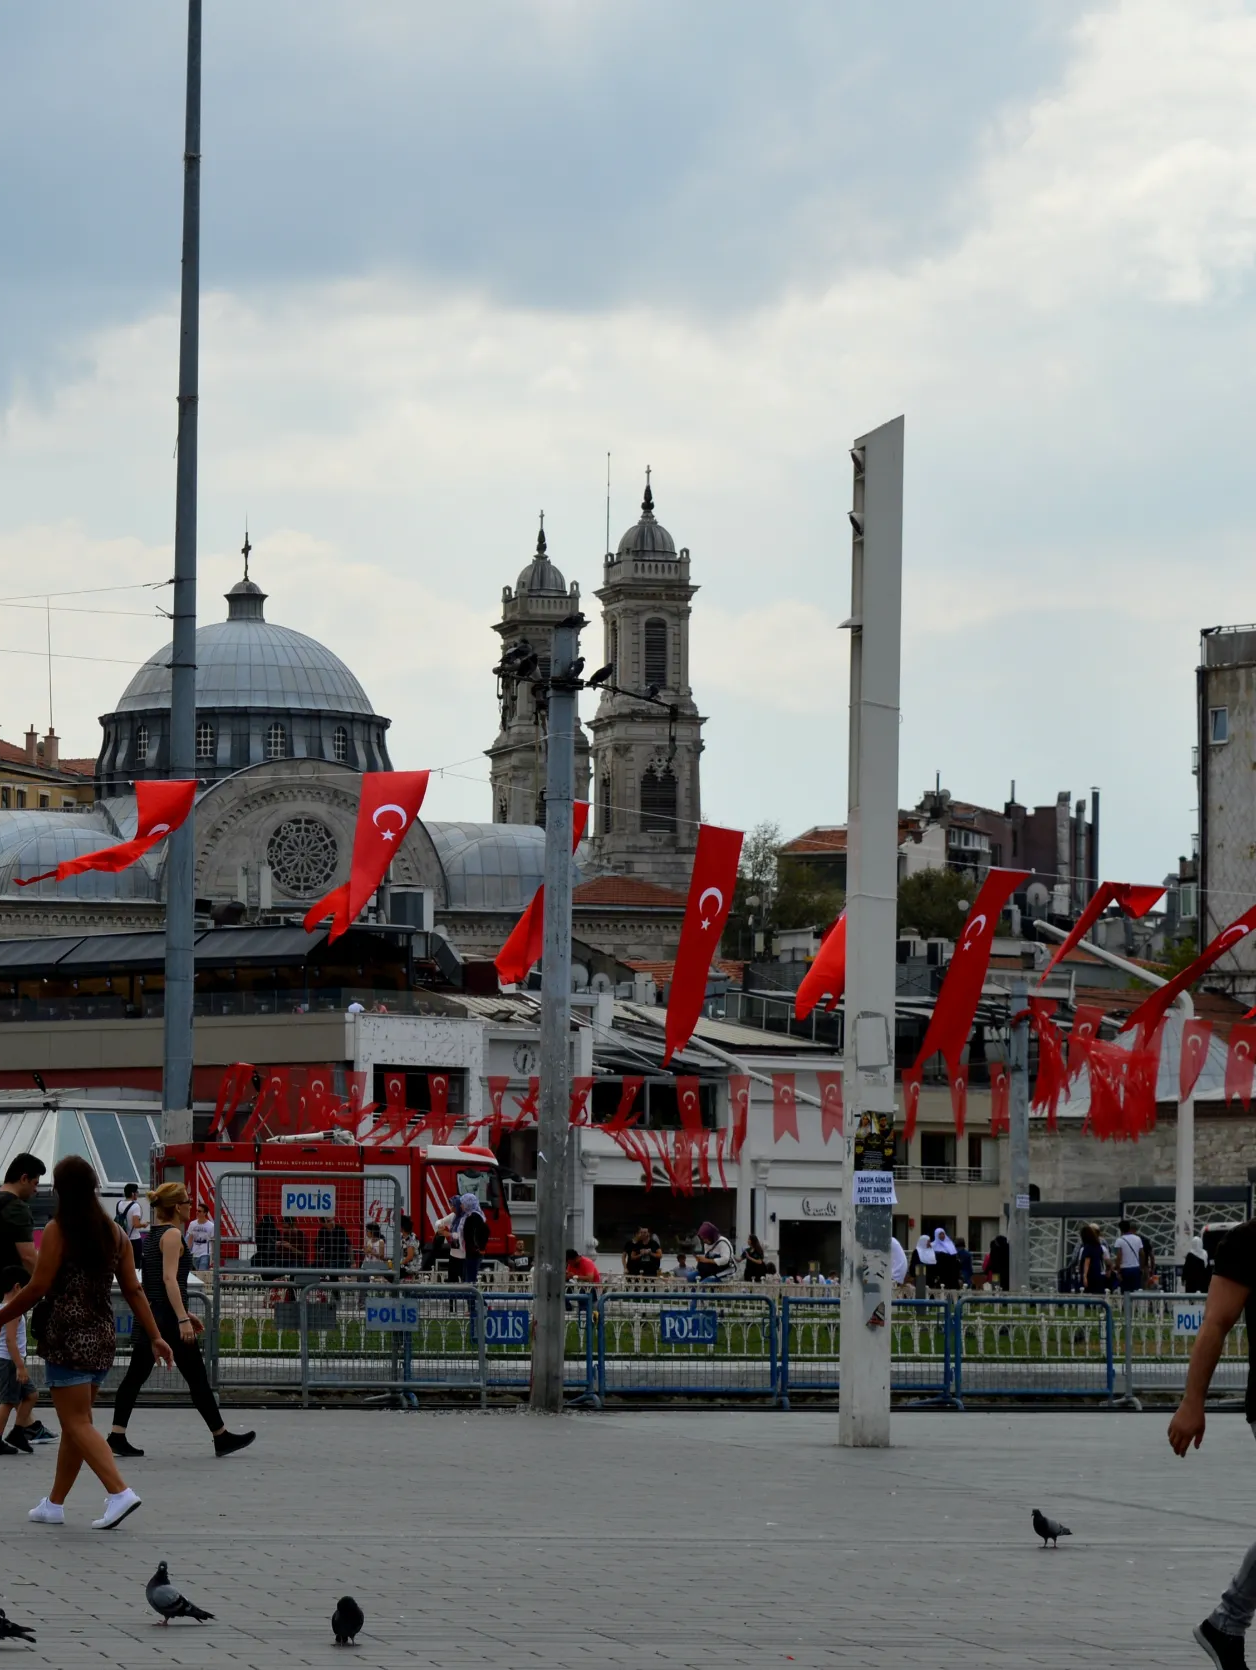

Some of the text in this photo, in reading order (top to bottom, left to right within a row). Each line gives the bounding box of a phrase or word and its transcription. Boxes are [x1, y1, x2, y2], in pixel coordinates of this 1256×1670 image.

[287, 1189, 332, 1210] POLİS
[367, 1304, 417, 1324] POLİS
[1177, 1310, 1205, 1330] POLİ
[473, 1311, 524, 1340] OLİS
[665, 1313, 714, 1339] POLİS
